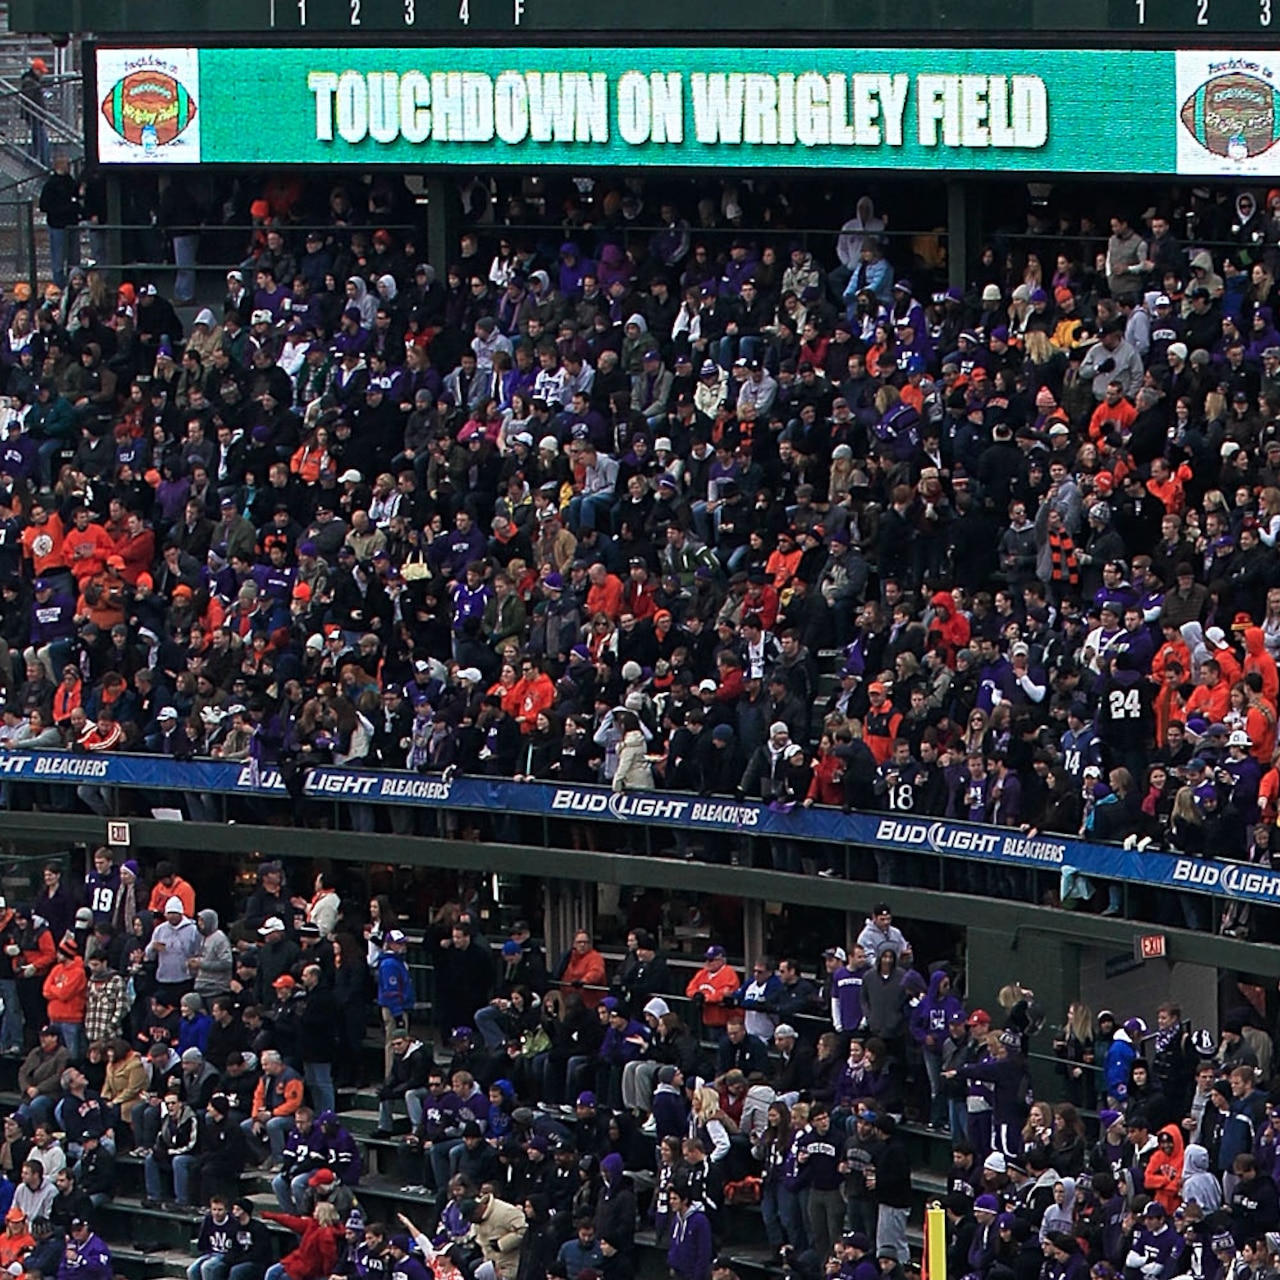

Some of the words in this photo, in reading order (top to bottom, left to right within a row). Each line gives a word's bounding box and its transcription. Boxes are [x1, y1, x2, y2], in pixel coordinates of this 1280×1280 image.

[350, 0, 361, 26] 2
[404, 0, 415, 26] 3
[458, 0, 469, 26] 4
[514, 0, 525, 26] F
[1197, 0, 1208, 26] 2
[1260, 0, 1271, 26] 3
[307, 70, 609, 144] TOUCHDOWN
[617, 70, 683, 144] ON
[691, 71, 909, 147] WRIGLEY
[916, 73, 1048, 148] FIELD
[1109, 689, 1141, 720] 24
[34, 757, 110, 777] BLEACHERS
[1065, 750, 1081, 775] 14
[304, 770, 379, 794] LIGHT
[380, 779, 451, 800] BLEACHERS
[888, 784, 914, 810] 18
[552, 789, 607, 812] BUD
[617, 795, 689, 819] LIGHT
[876, 820, 927, 844] BUD
[936, 826, 1000, 853] LIGHT
[1002, 837, 1067, 863] BLEACHERS
[1173, 860, 1220, 886] BUD
[92, 888, 113, 914] 19
[1143, 936, 1164, 956] EXIT
